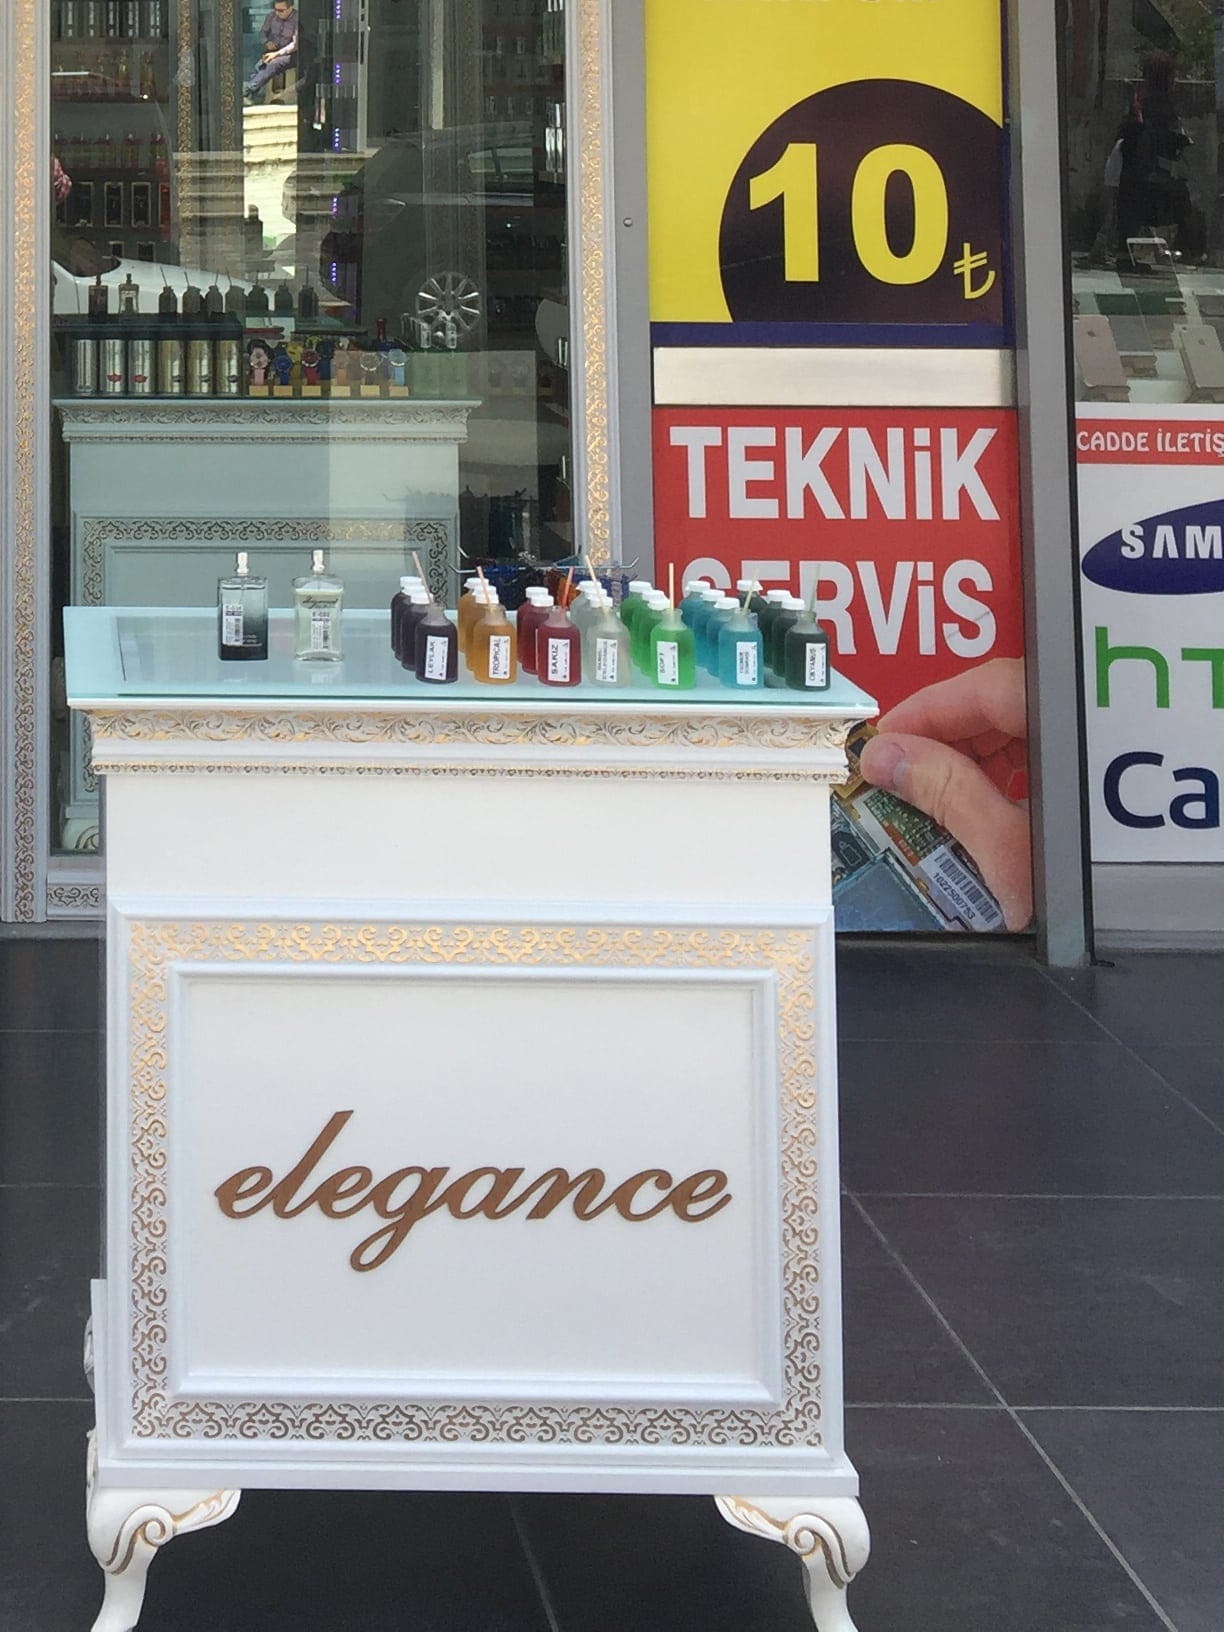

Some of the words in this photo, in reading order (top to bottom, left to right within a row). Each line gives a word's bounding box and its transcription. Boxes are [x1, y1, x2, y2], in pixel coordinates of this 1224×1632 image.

[748, 142, 950, 286] 10
[1076, 430, 1150, 453] CADDE
[214, 1109, 732, 1273] elegance
